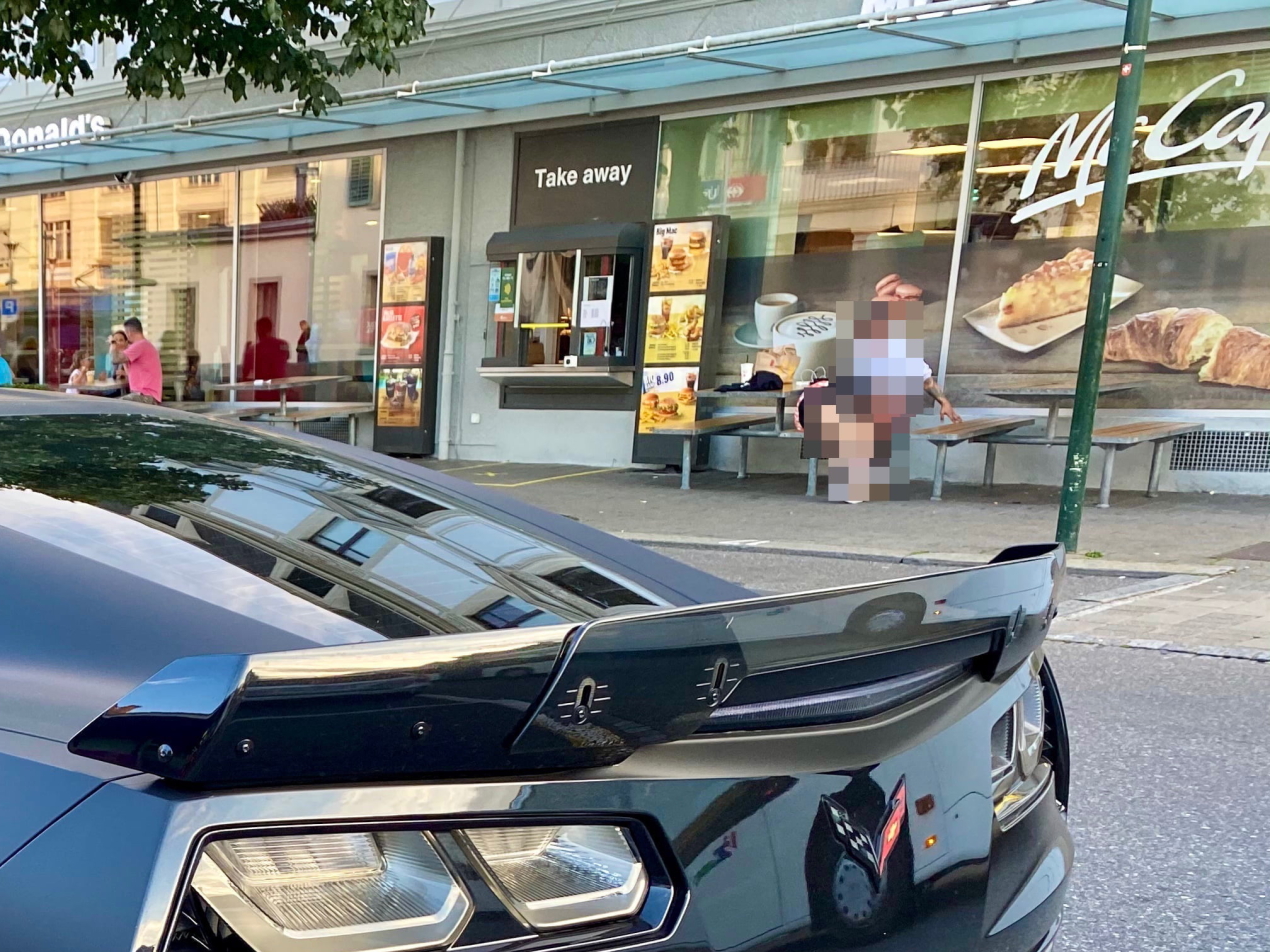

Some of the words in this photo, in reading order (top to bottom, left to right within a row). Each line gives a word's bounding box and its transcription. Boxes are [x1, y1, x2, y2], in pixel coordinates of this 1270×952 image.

[534, 166, 578, 188] Take
[582, 163, 632, 186] away
[656, 227, 665, 236] Big
[656, 371, 675, 386] 8.90
